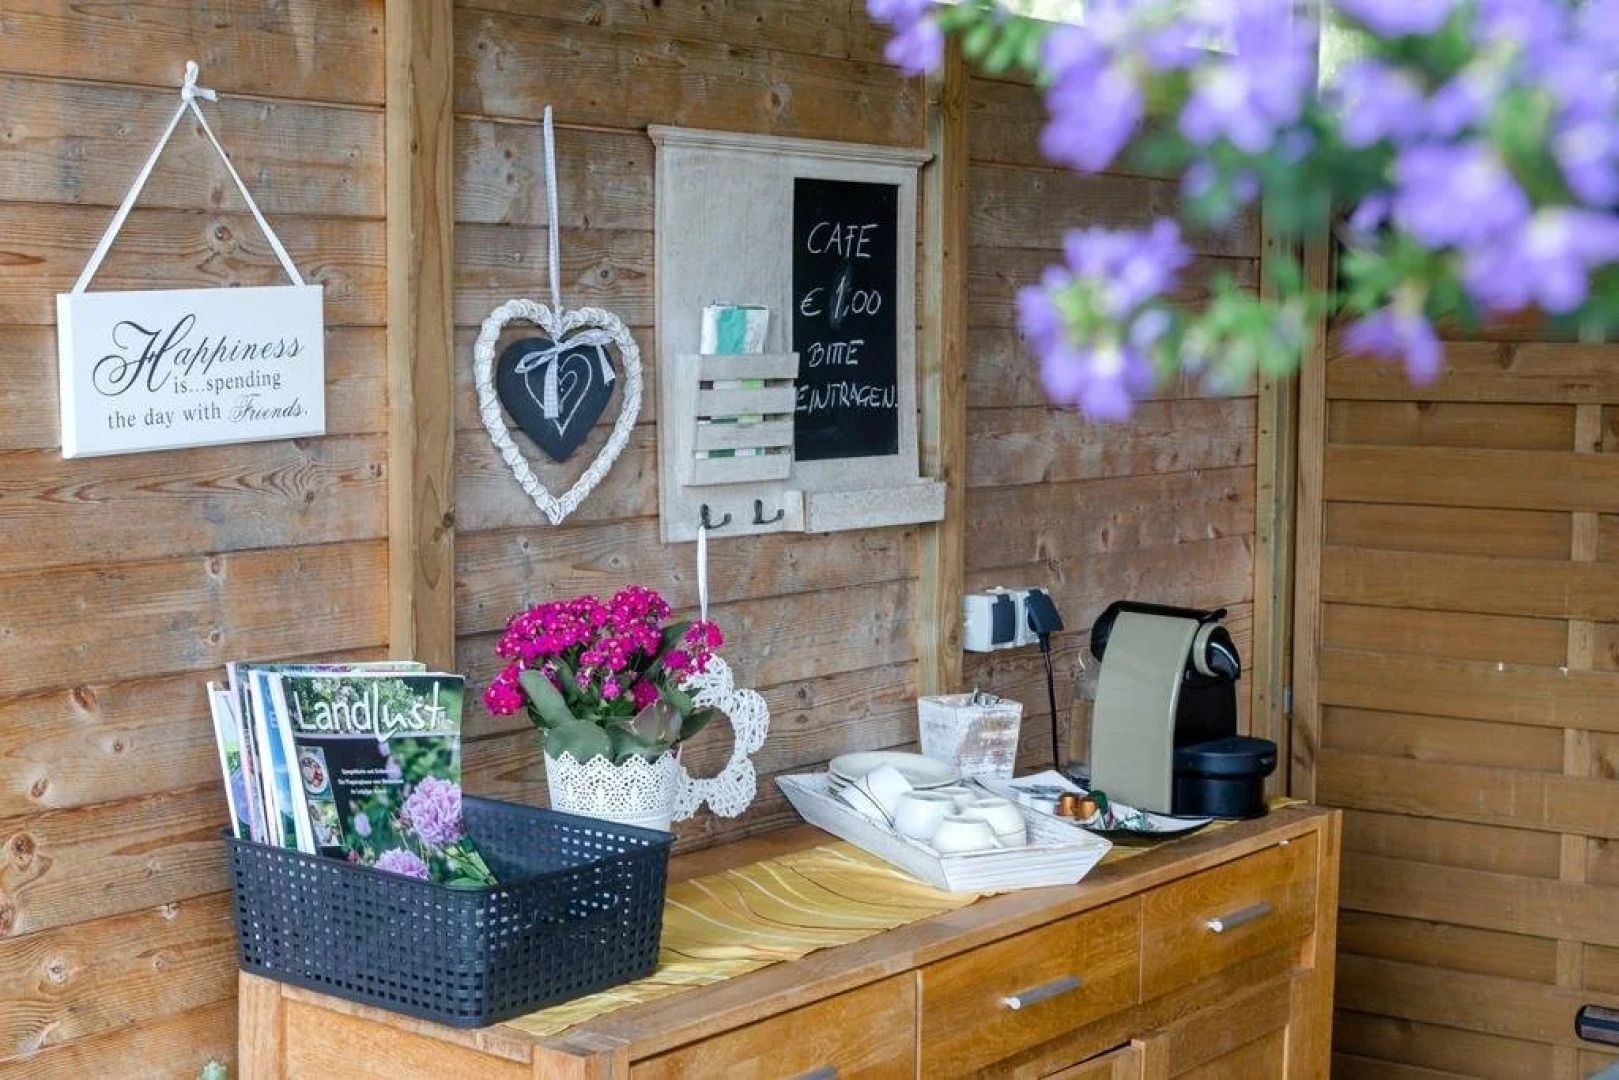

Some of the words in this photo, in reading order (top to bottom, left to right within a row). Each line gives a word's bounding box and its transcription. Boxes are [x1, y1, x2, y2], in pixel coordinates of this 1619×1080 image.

[807, 221, 879, 259] CAFE
[93, 313, 305, 395] Happiness
[807, 339, 865, 368] BITTE
[108, 411, 137, 429] the
[144, 407, 175, 428] day
[183, 402, 221, 422] with
